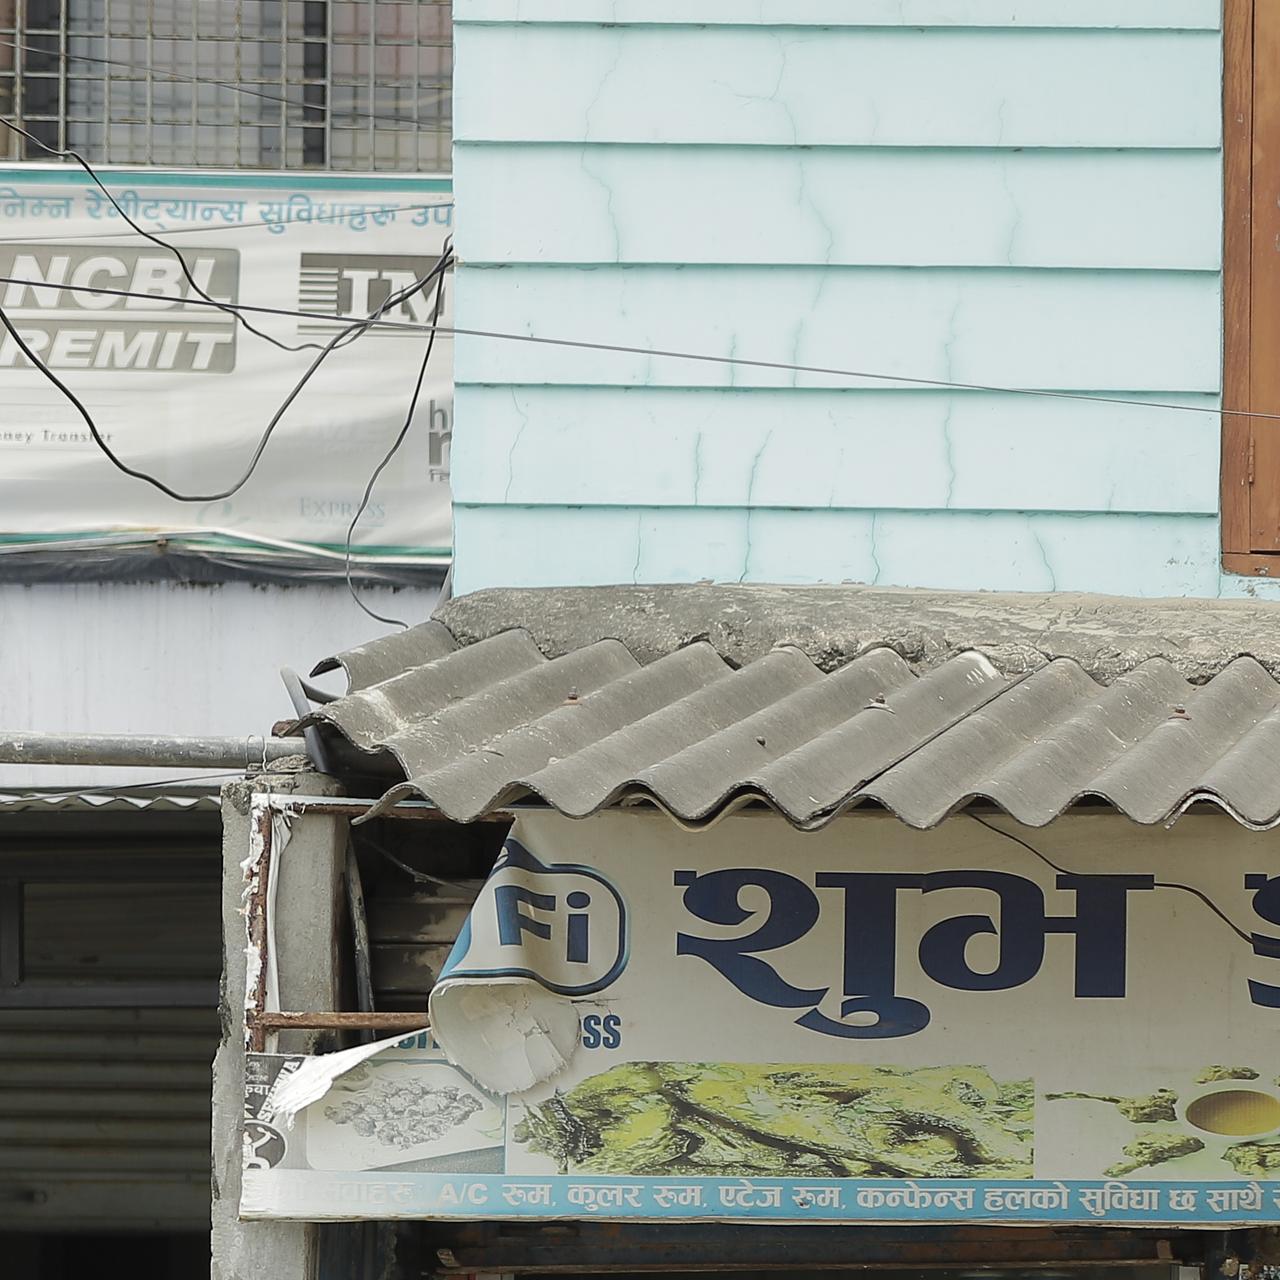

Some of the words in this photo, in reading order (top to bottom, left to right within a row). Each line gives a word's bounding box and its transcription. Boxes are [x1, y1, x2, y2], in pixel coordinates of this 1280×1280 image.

[3, 255, 232, 311] NCBL
[0, 328, 234, 371] REMIT
[673, 867, 1155, 1040] शुभ
[440, 1182, 489, 1205] A/C
[567, 1184, 645, 1212] कुलर
[984, 1182, 1071, 1212] हलको
[1078, 1182, 1160, 1217] सुविधा
[1168, 1187, 1197, 1213] छ
[1206, 1182, 1265, 1213] साथै
